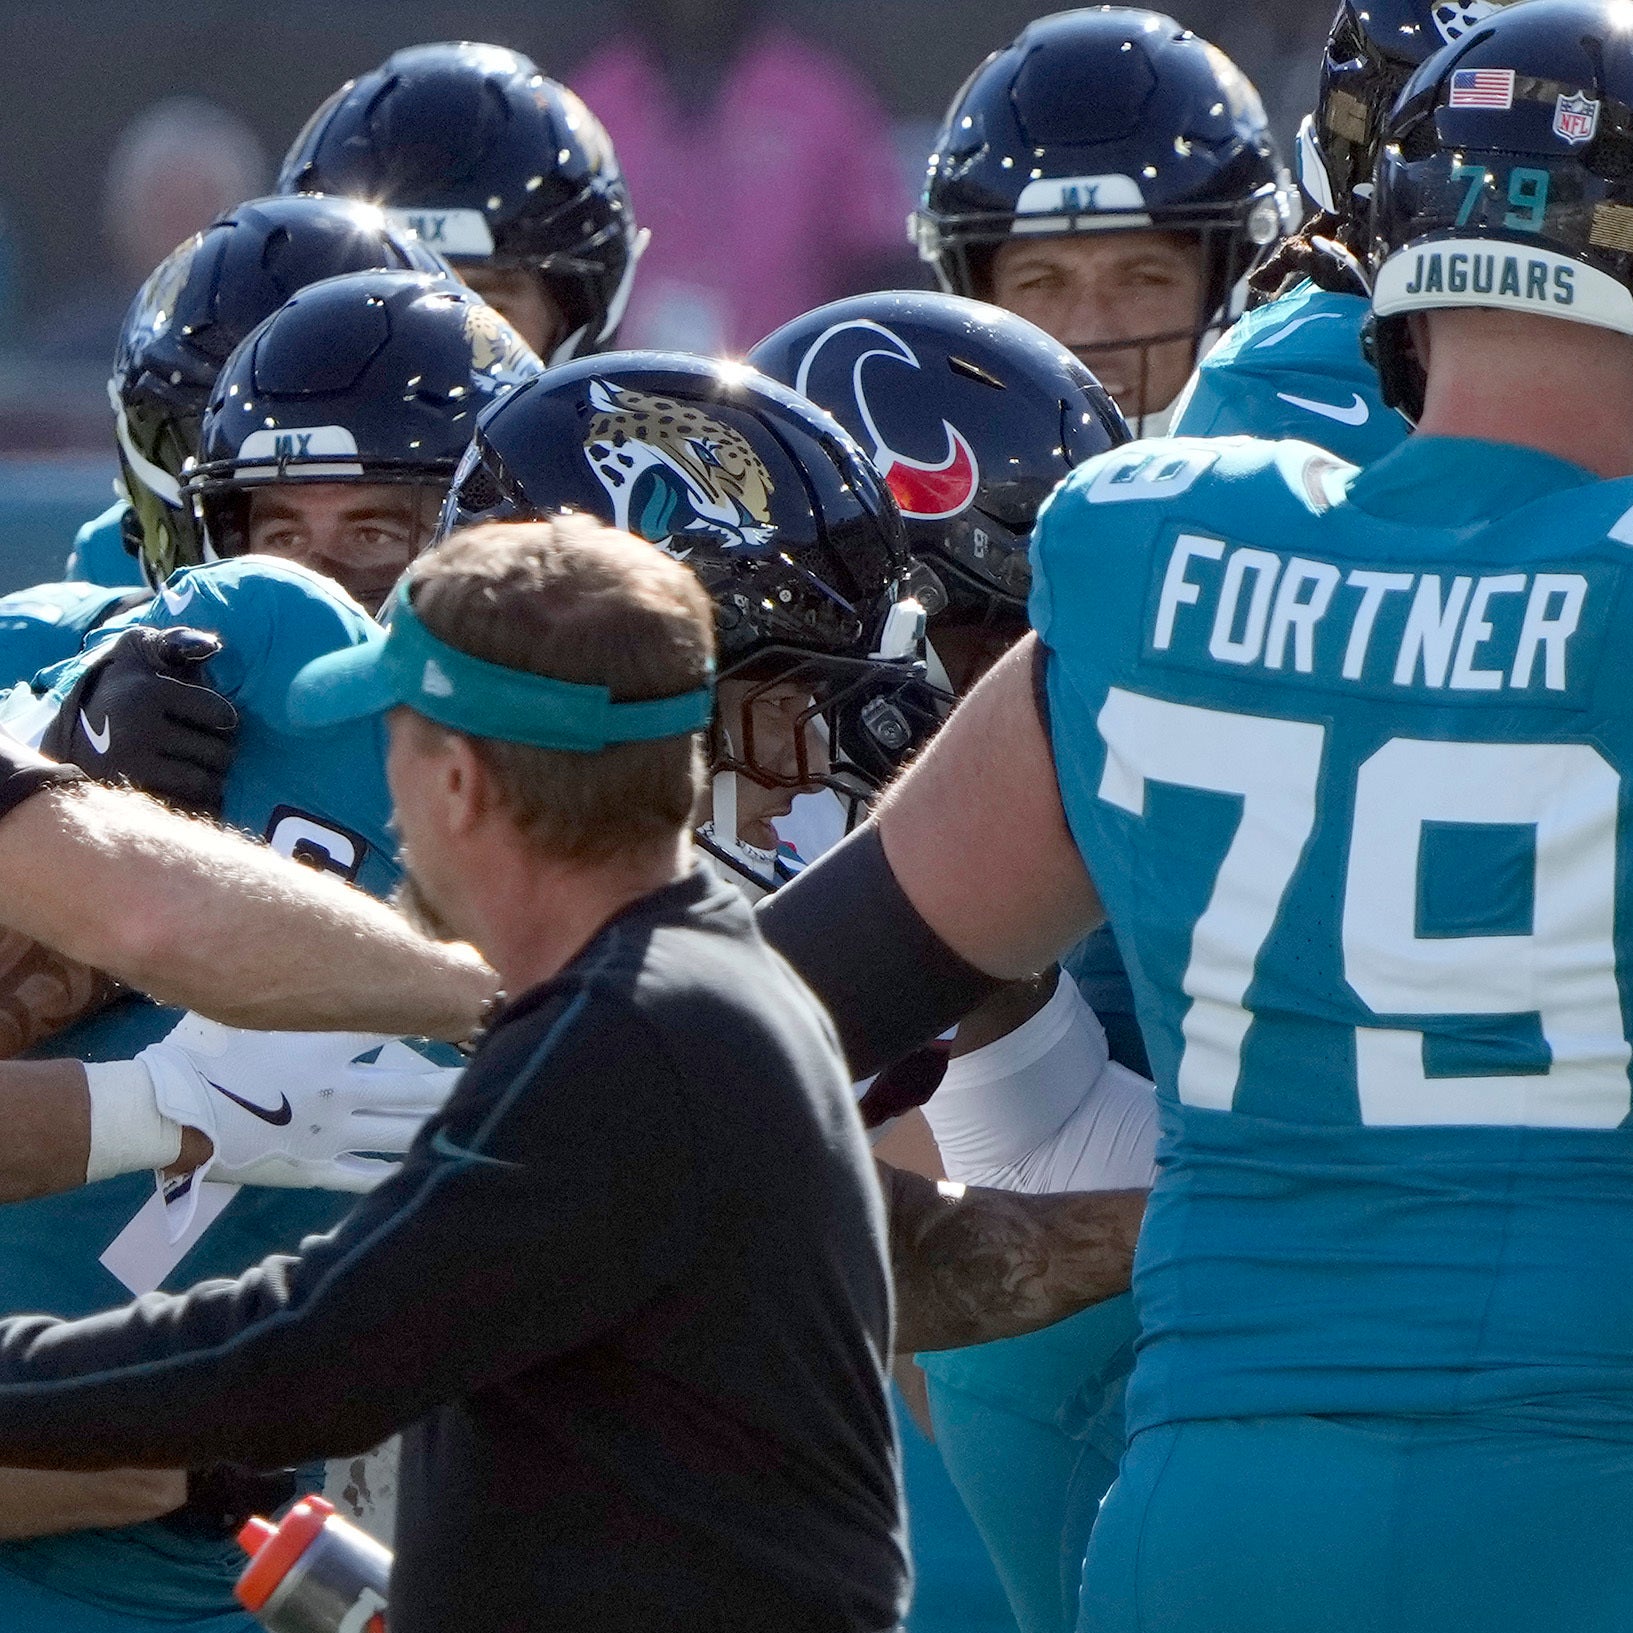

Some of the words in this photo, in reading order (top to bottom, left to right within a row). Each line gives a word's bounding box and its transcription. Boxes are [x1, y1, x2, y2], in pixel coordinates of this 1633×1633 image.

[1451, 165, 1550, 233] 79
[1406, 253, 1575, 305] JAGUARS
[1152, 533, 1588, 694] FORTNER
[1096, 686, 1633, 1130] 79
